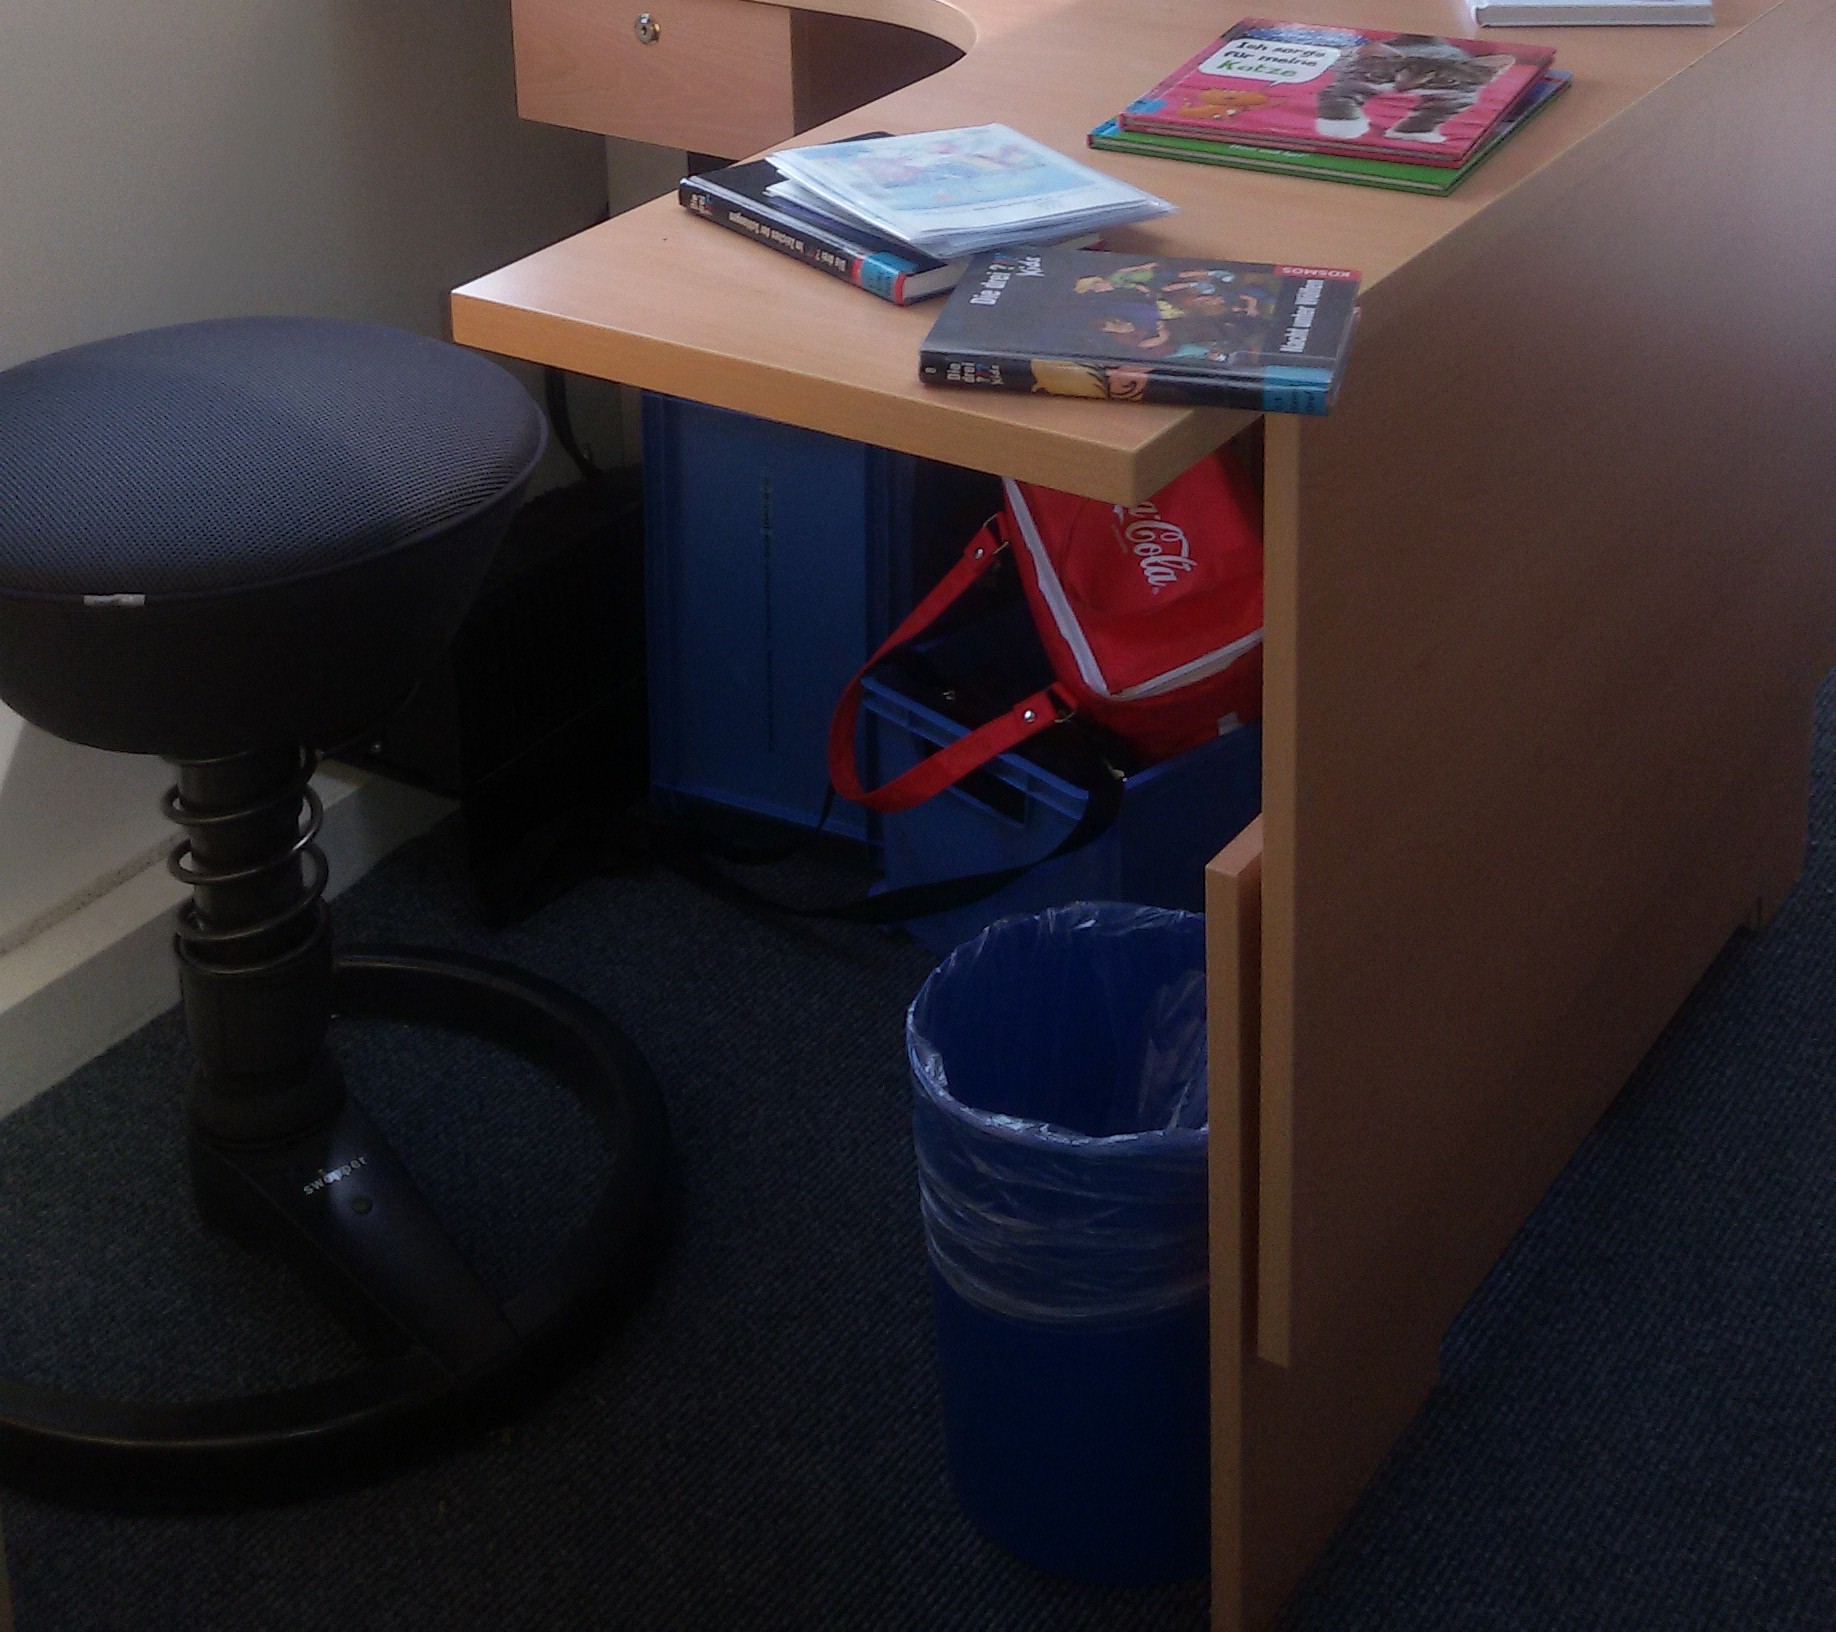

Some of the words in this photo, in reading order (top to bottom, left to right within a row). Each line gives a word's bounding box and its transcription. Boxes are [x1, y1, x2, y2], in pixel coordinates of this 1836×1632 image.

[1223, 49, 1255, 61] für
[1258, 54, 1318, 67] meine
[1235, 40, 1268, 52] Ich
[1271, 45, 1327, 58] sorge
[1217, 60, 1298, 77] Katze
[979, 270, 1012, 289] drei
[1281, 266, 1352, 278] KOSMOS
[969, 289, 1002, 306] Die
[946, 362, 962, 381] Die
